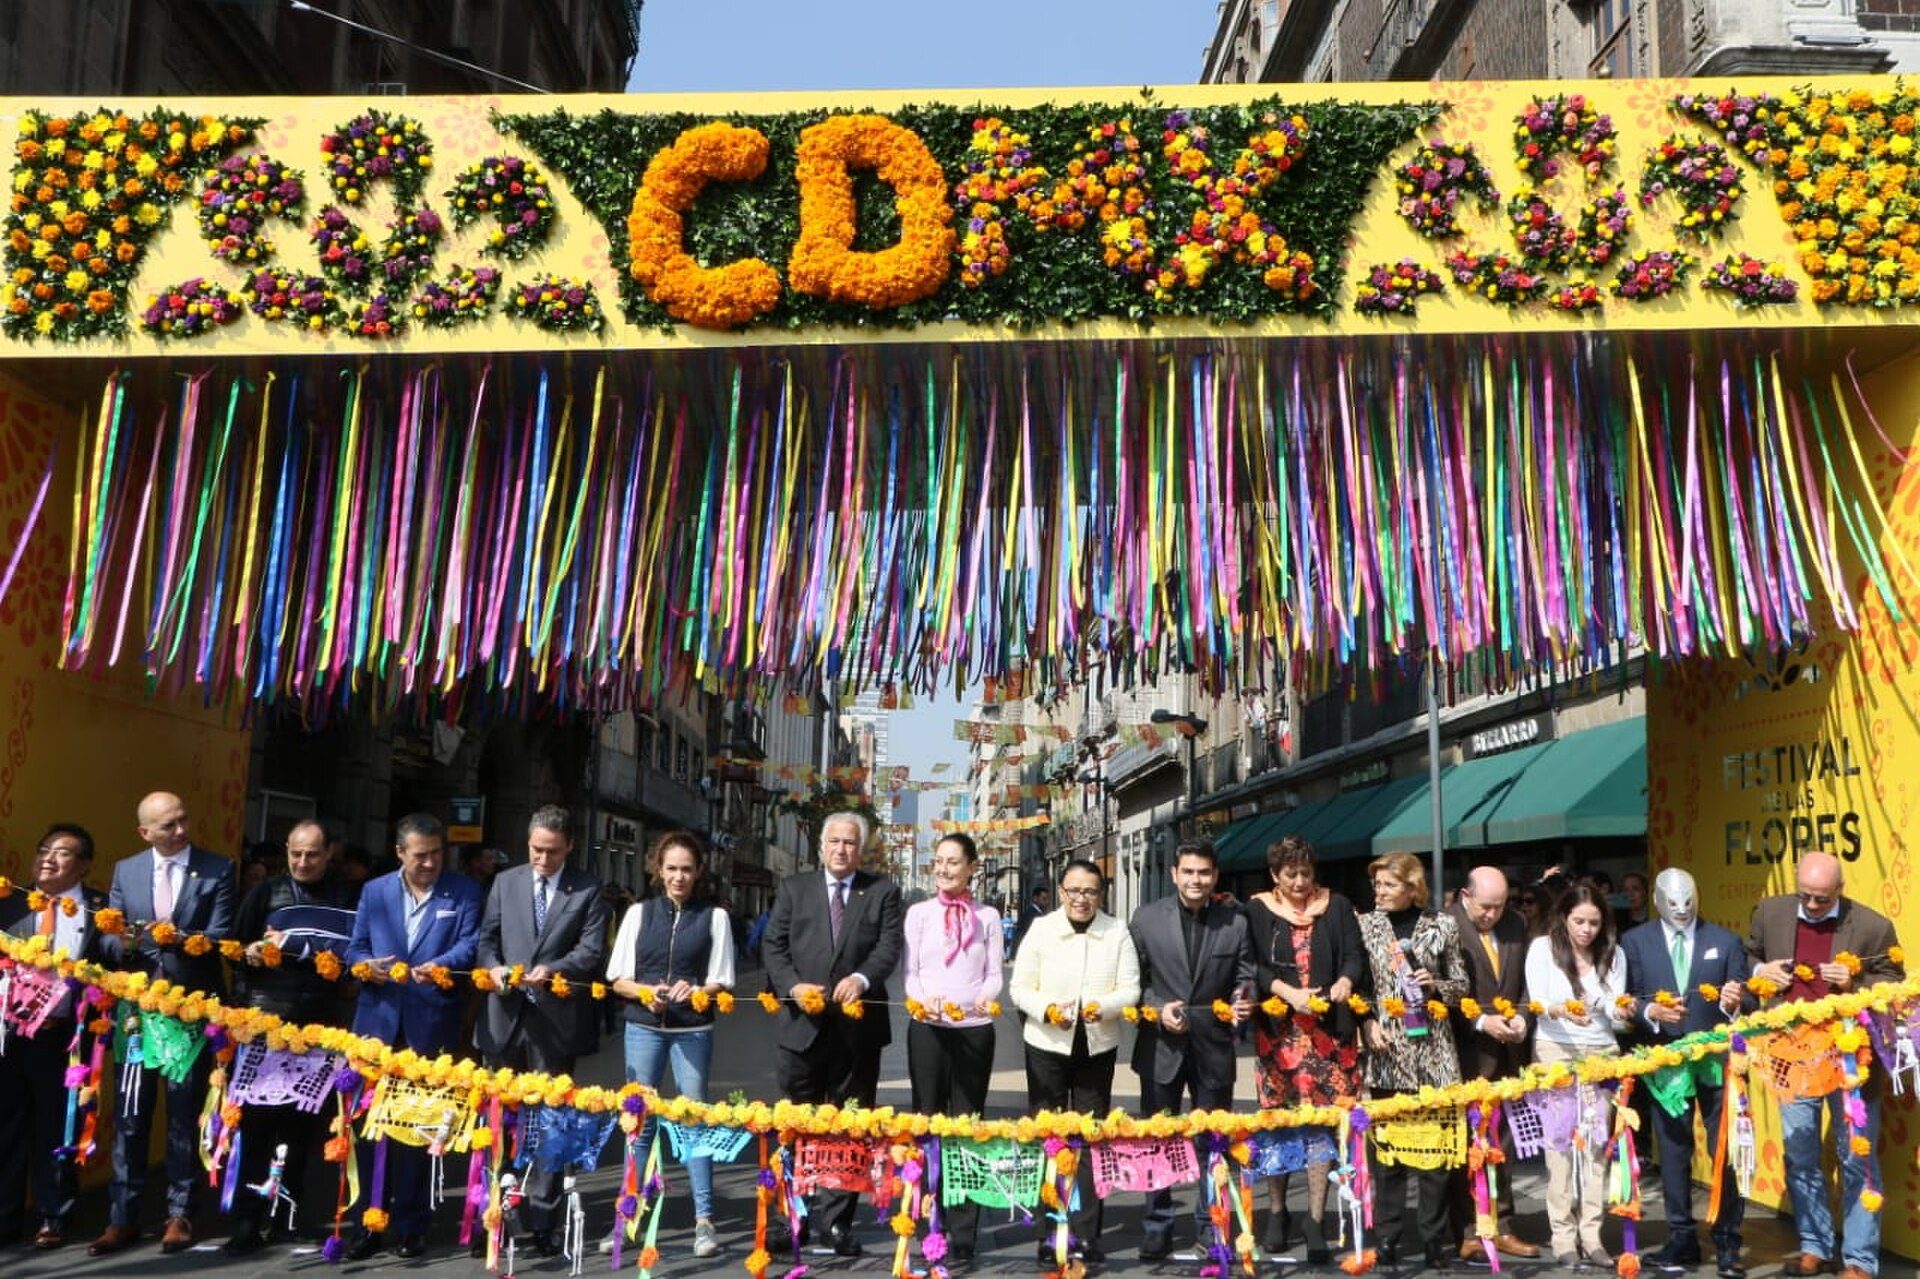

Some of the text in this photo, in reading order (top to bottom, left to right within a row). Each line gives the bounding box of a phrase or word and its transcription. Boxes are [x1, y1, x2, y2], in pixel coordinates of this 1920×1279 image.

[627, 111, 1315, 329] CDMX
[1721, 736, 1861, 791] FESTIVAL
[1785, 788, 1814, 811] LAS
[1725, 811, 1862, 866] FLORES
